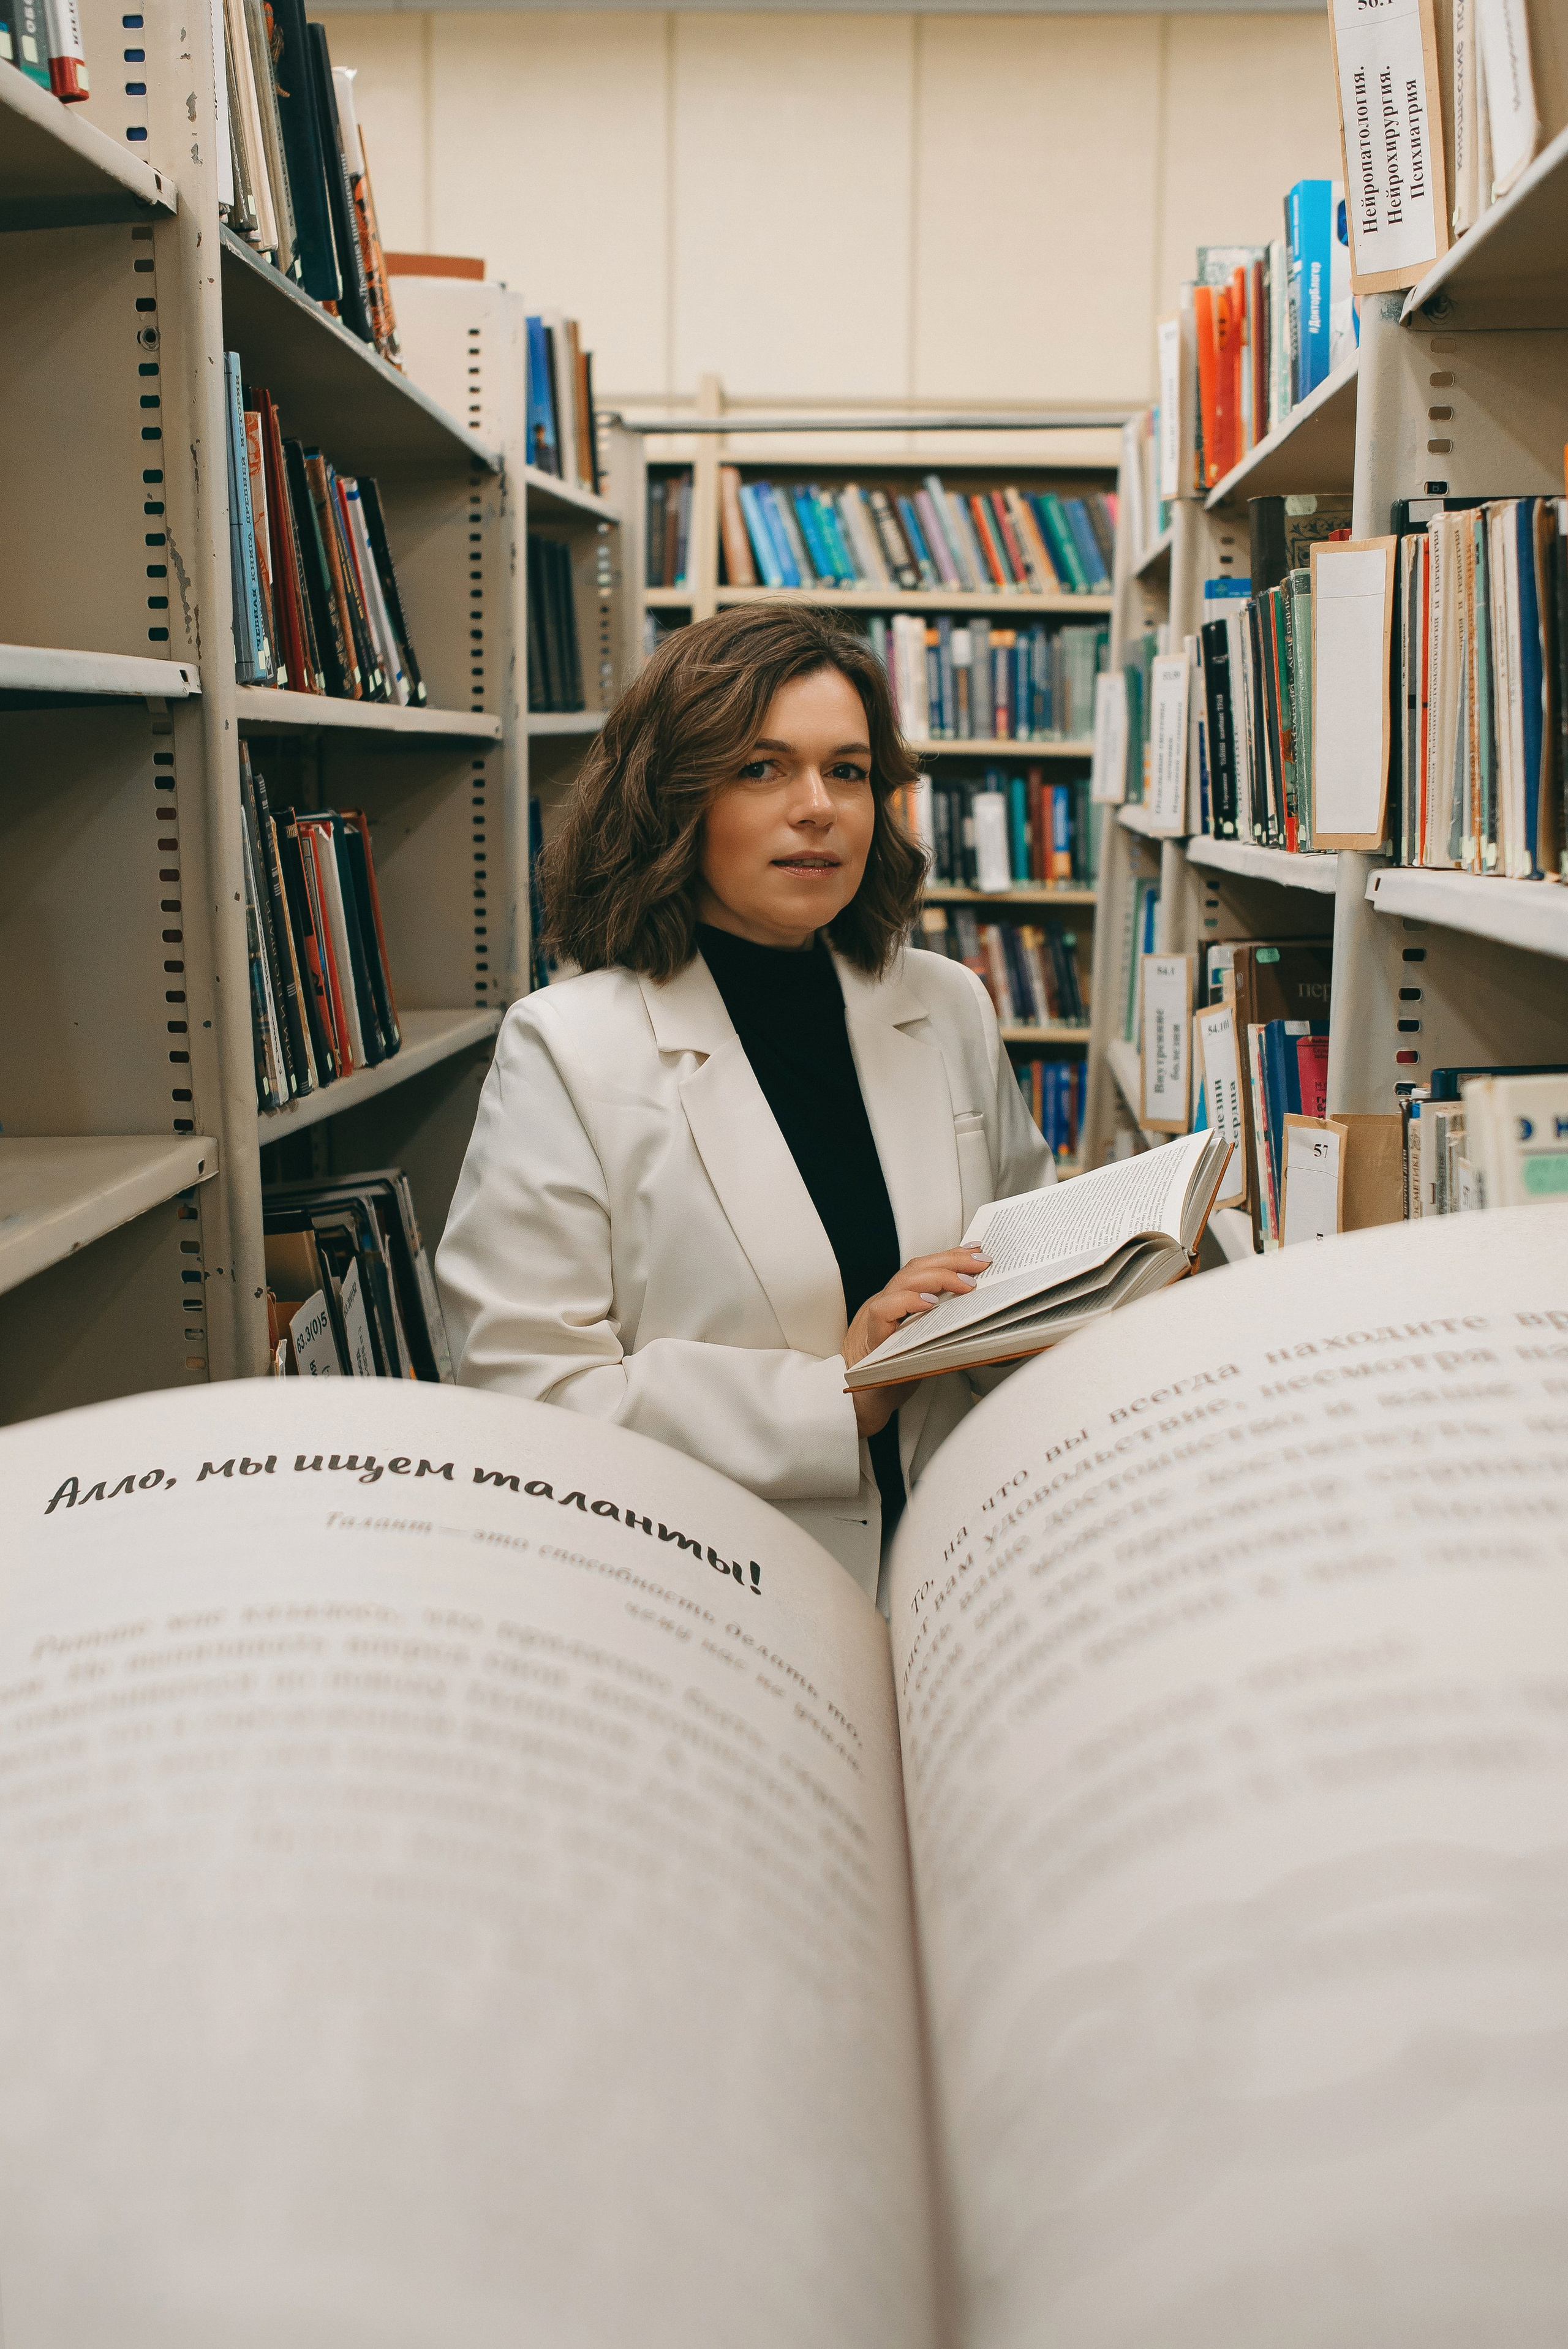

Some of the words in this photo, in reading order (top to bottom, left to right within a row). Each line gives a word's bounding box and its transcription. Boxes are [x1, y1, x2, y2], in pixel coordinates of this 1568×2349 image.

[1353, 66, 1379, 235] Нейропатология.
[1379, 65, 1404, 225] Нейрохирургия.
[1405, 79, 1425, 201] Психиатрия
[1308, 262, 1322, 334] #ДокторБлогер
[233, 375, 244, 447] ИСТОРИИ
[239, 456, 251, 524] ДРЕВНЕЙ
[247, 532, 256, 581] КНИГА
[265, 899, 276, 956] ВРАГИ
[274, 963, 282, 997] ЕГО
[281, 1004, 285, 1018] И
[283, 1026, 293, 1070] РИМ
[1155, 1008, 1166, 1094] Внутренние
[1170, 1024, 1181, 1081] болезни
[1214, 1078, 1226, 1139] лезни
[1229, 1080, 1242, 1150] сердца
[296, 1311, 328, 1354] 63.3(0)5
[943, 1524, 968, 1563] на
[980, 1469, 1029, 1512] что
[1045, 1427, 1090, 1463] вы
[1106, 1362, 1241, 1425] всегда
[1263, 1313, 1491, 1366] находите
[44, 1468, 177, 1515] Алло,
[196, 1454, 278, 1482] мы
[293, 1454, 454, 1484] ищем
[472, 1466, 762, 1596] таланты!
[325, 1510, 435, 1533] Талант
[472, 1528, 530, 1552] это
[538, 1543, 717, 1626] способность
[724, 1620, 821, 1700] делать
